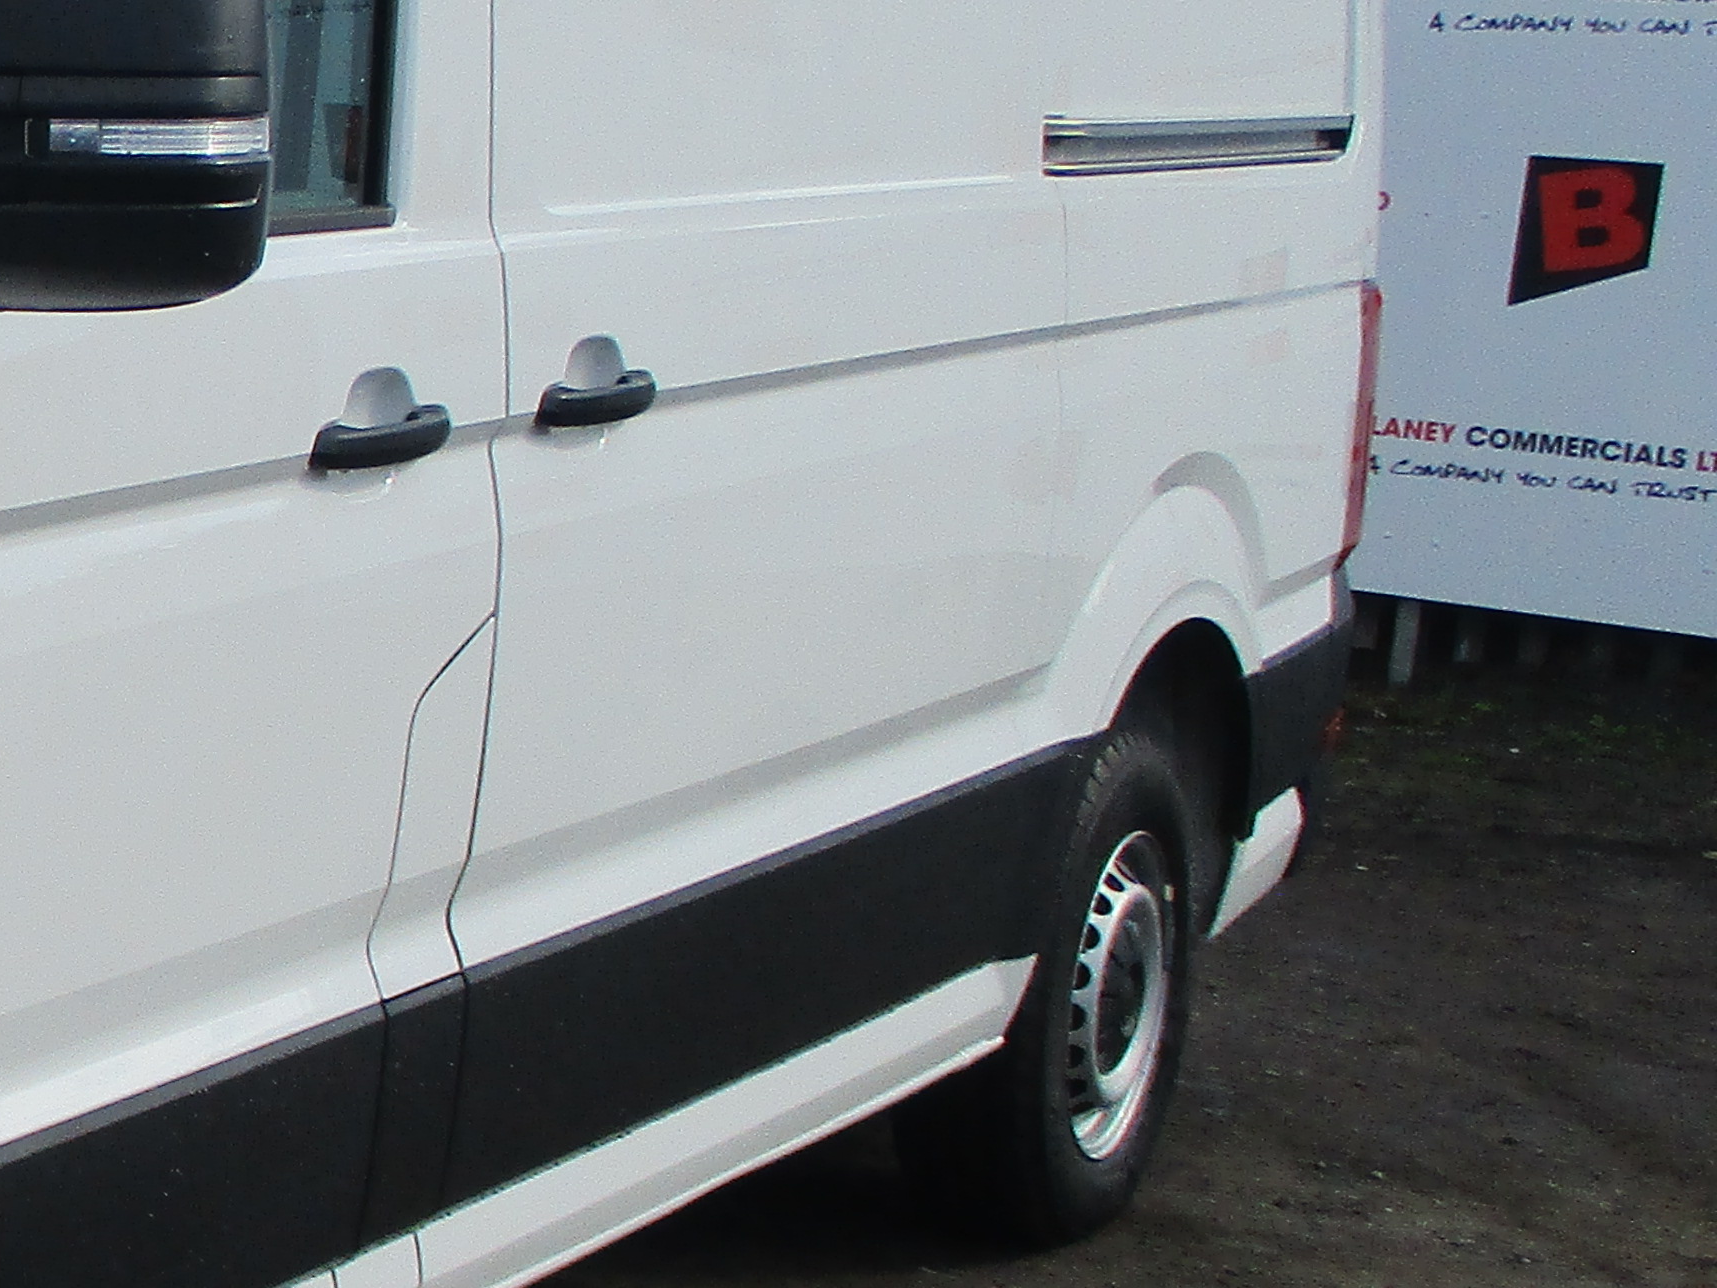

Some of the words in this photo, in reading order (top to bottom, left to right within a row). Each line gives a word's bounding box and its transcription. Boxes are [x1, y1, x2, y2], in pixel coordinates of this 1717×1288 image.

[1455, 14, 1575, 32] COMPANY
[1585, 17, 1628, 34] YOU
[1637, 17, 1691, 36] CAN
[1466, 425, 1688, 470] COMMERCIALS
[1389, 459, 1506, 485] COMPANY
[1515, 470, 1557, 489] YOU
[1566, 475, 1620, 495] CAN
[1629, 480, 1717, 503] TRUST
